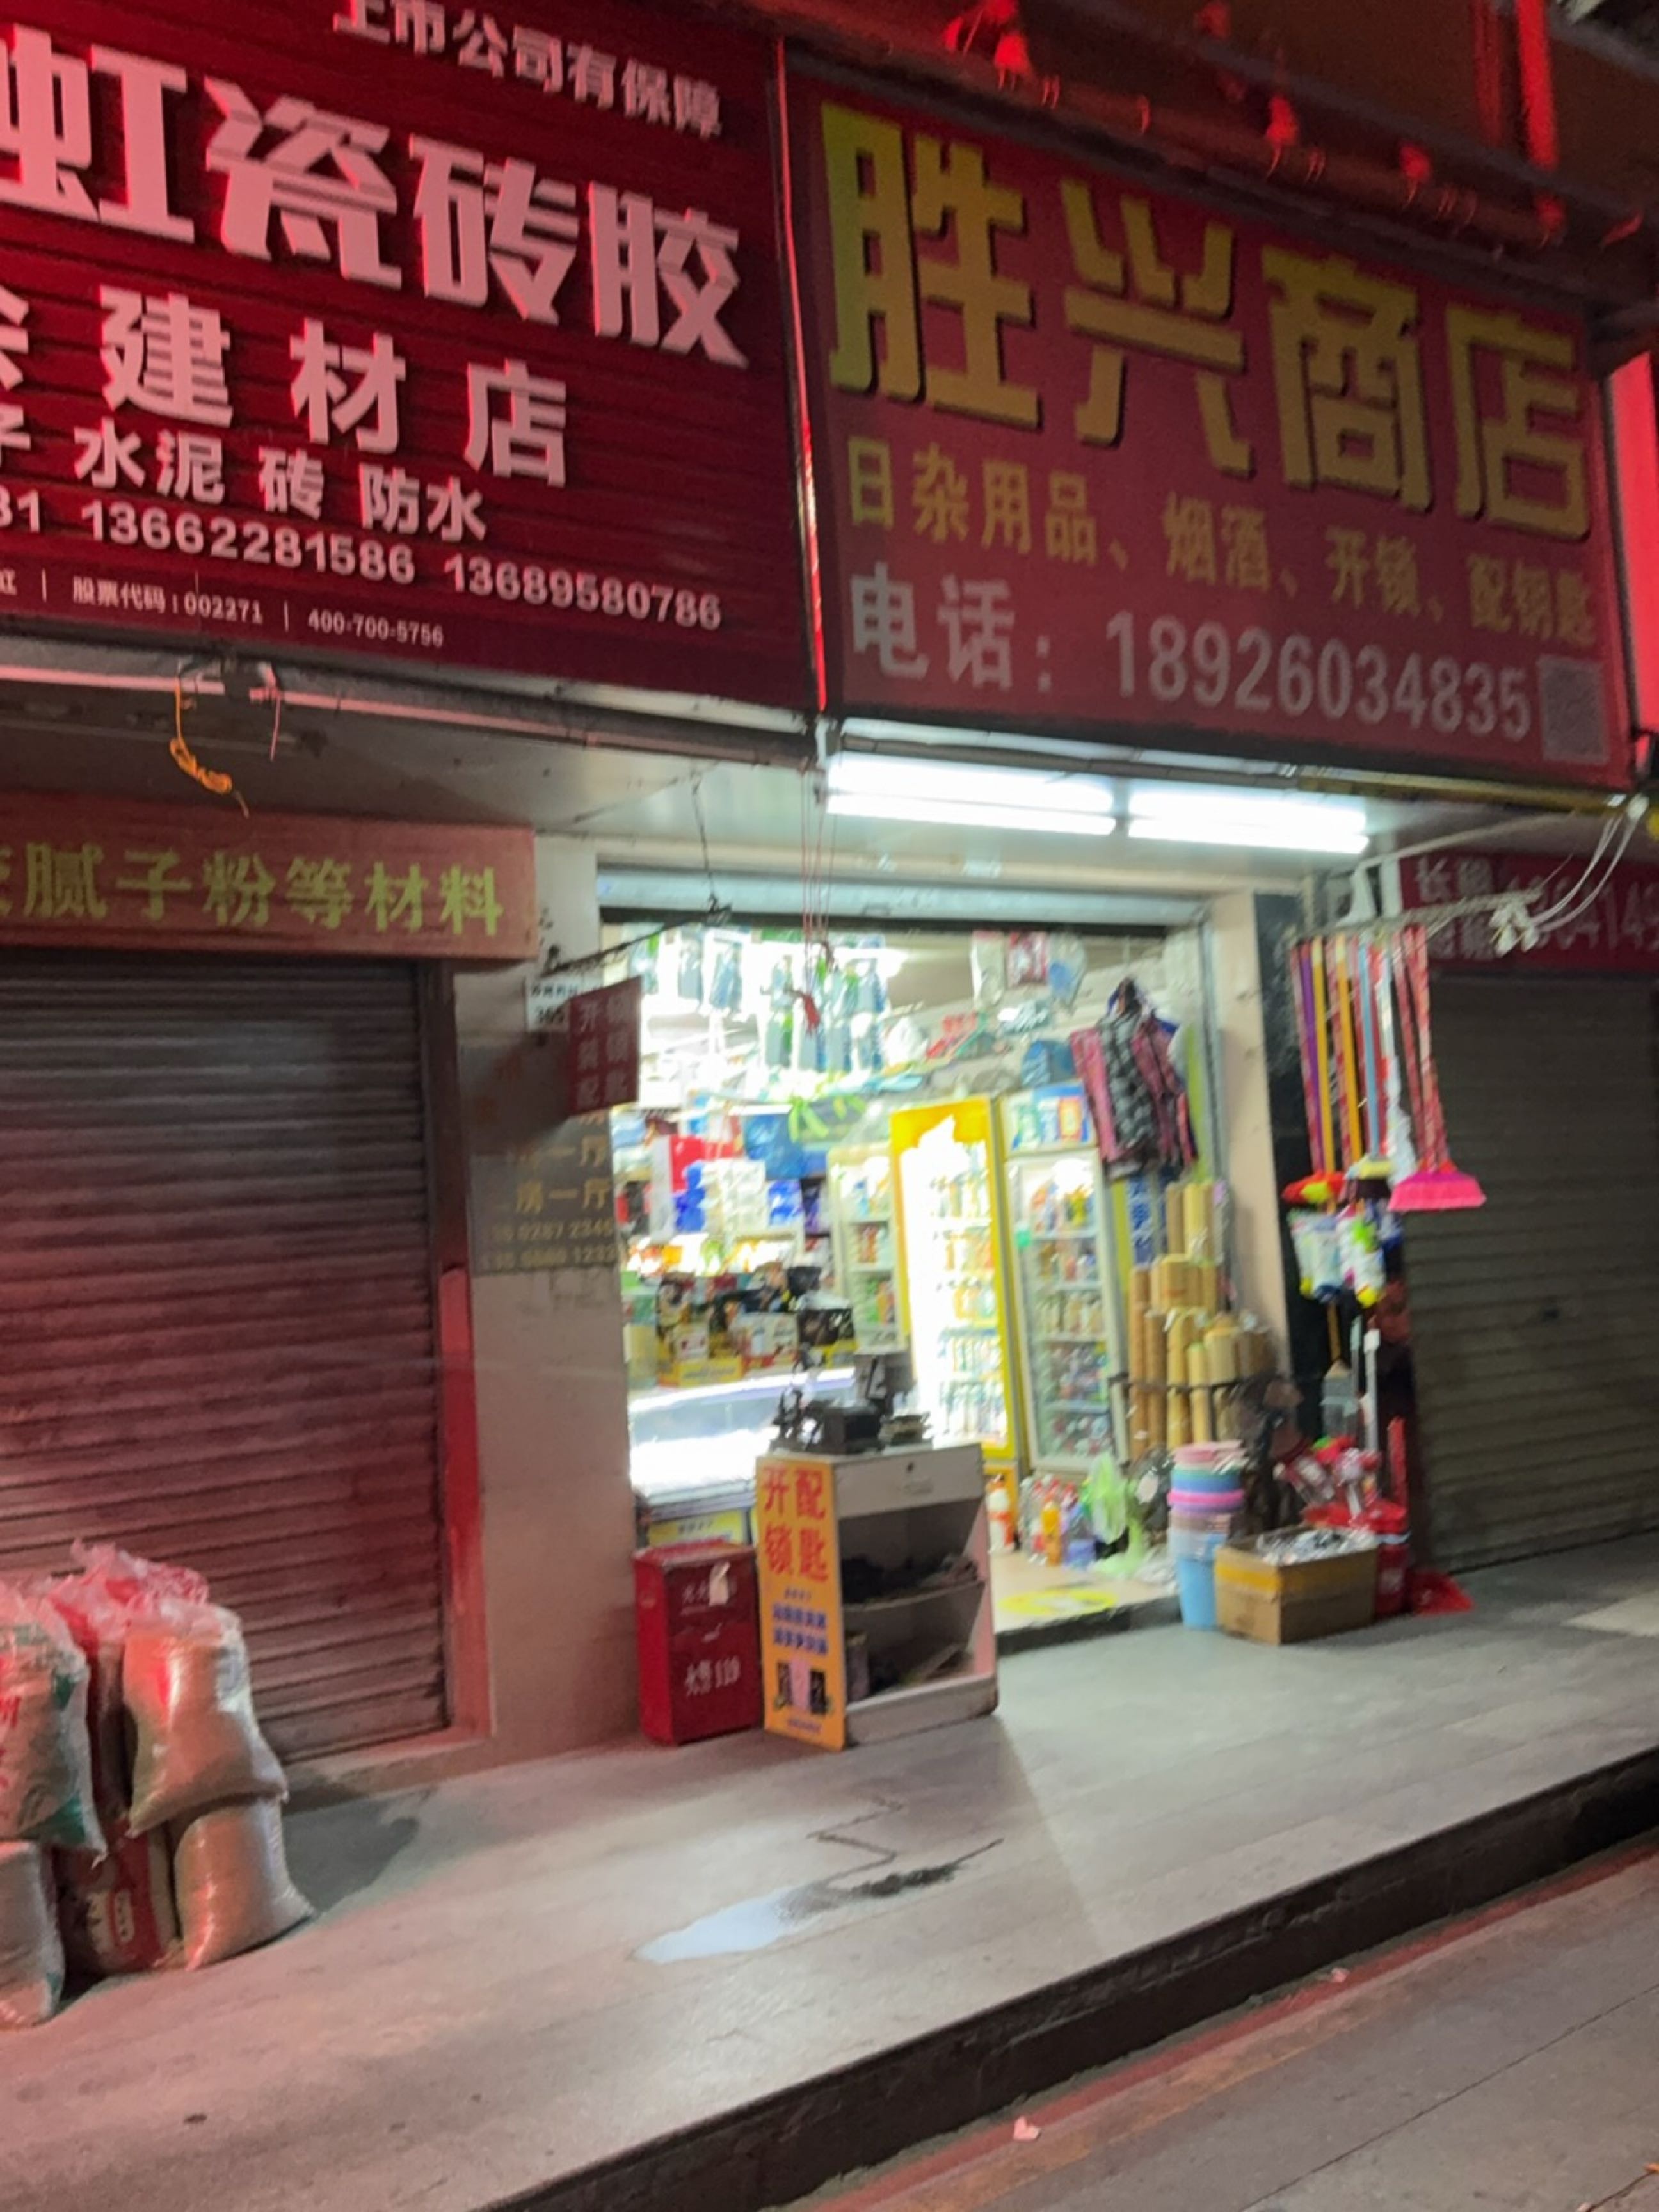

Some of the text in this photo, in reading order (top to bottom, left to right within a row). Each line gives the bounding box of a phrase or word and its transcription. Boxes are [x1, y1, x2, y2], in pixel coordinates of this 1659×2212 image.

[332, 0, 721, 138] 上市公司有保障
[0, 23, 748, 369] 虹瓷砖胶
[822, 104, 1591, 541] 胜兴商店
[74, 417, 225, 504] 水泥
[258, 445, 325, 520] 砖
[358, 463, 486, 541] 防水
[81, 500, 416, 584] 13662281586
[442, 552, 721, 630] 13689580786
[308, 607, 444, 648] 400-700-5756
[1106, 611, 1532, 741] 18926034835
